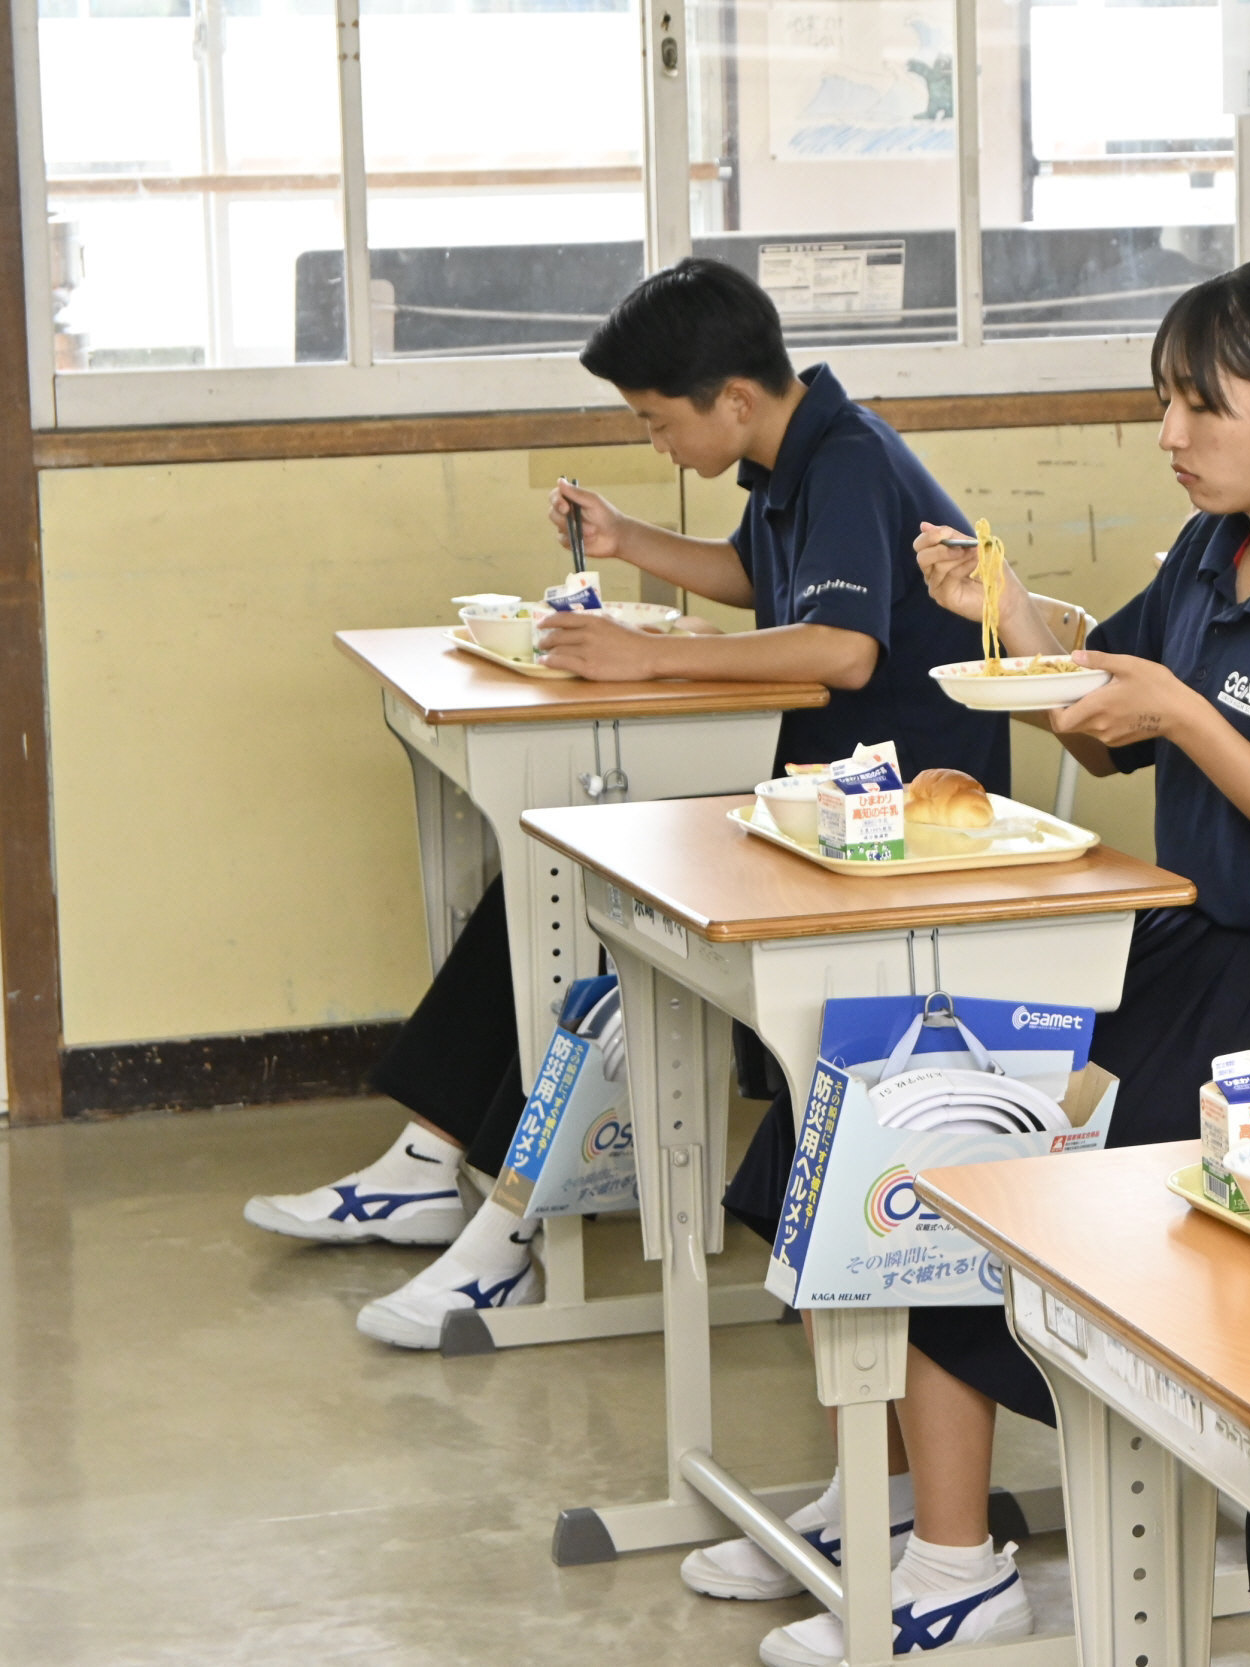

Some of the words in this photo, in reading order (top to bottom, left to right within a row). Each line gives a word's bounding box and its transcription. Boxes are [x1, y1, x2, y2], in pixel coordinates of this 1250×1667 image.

[858, 795, 893, 806] ひまわり
[776, 1070, 834, 1268] 防災用ヘルメット
[846, 1245, 944, 1274] その瞬間に、
[882, 1256, 977, 1290] すぐ被れる!
[811, 1292, 835, 1302] KAGA
[837, 1292, 872, 1302] HELMET
